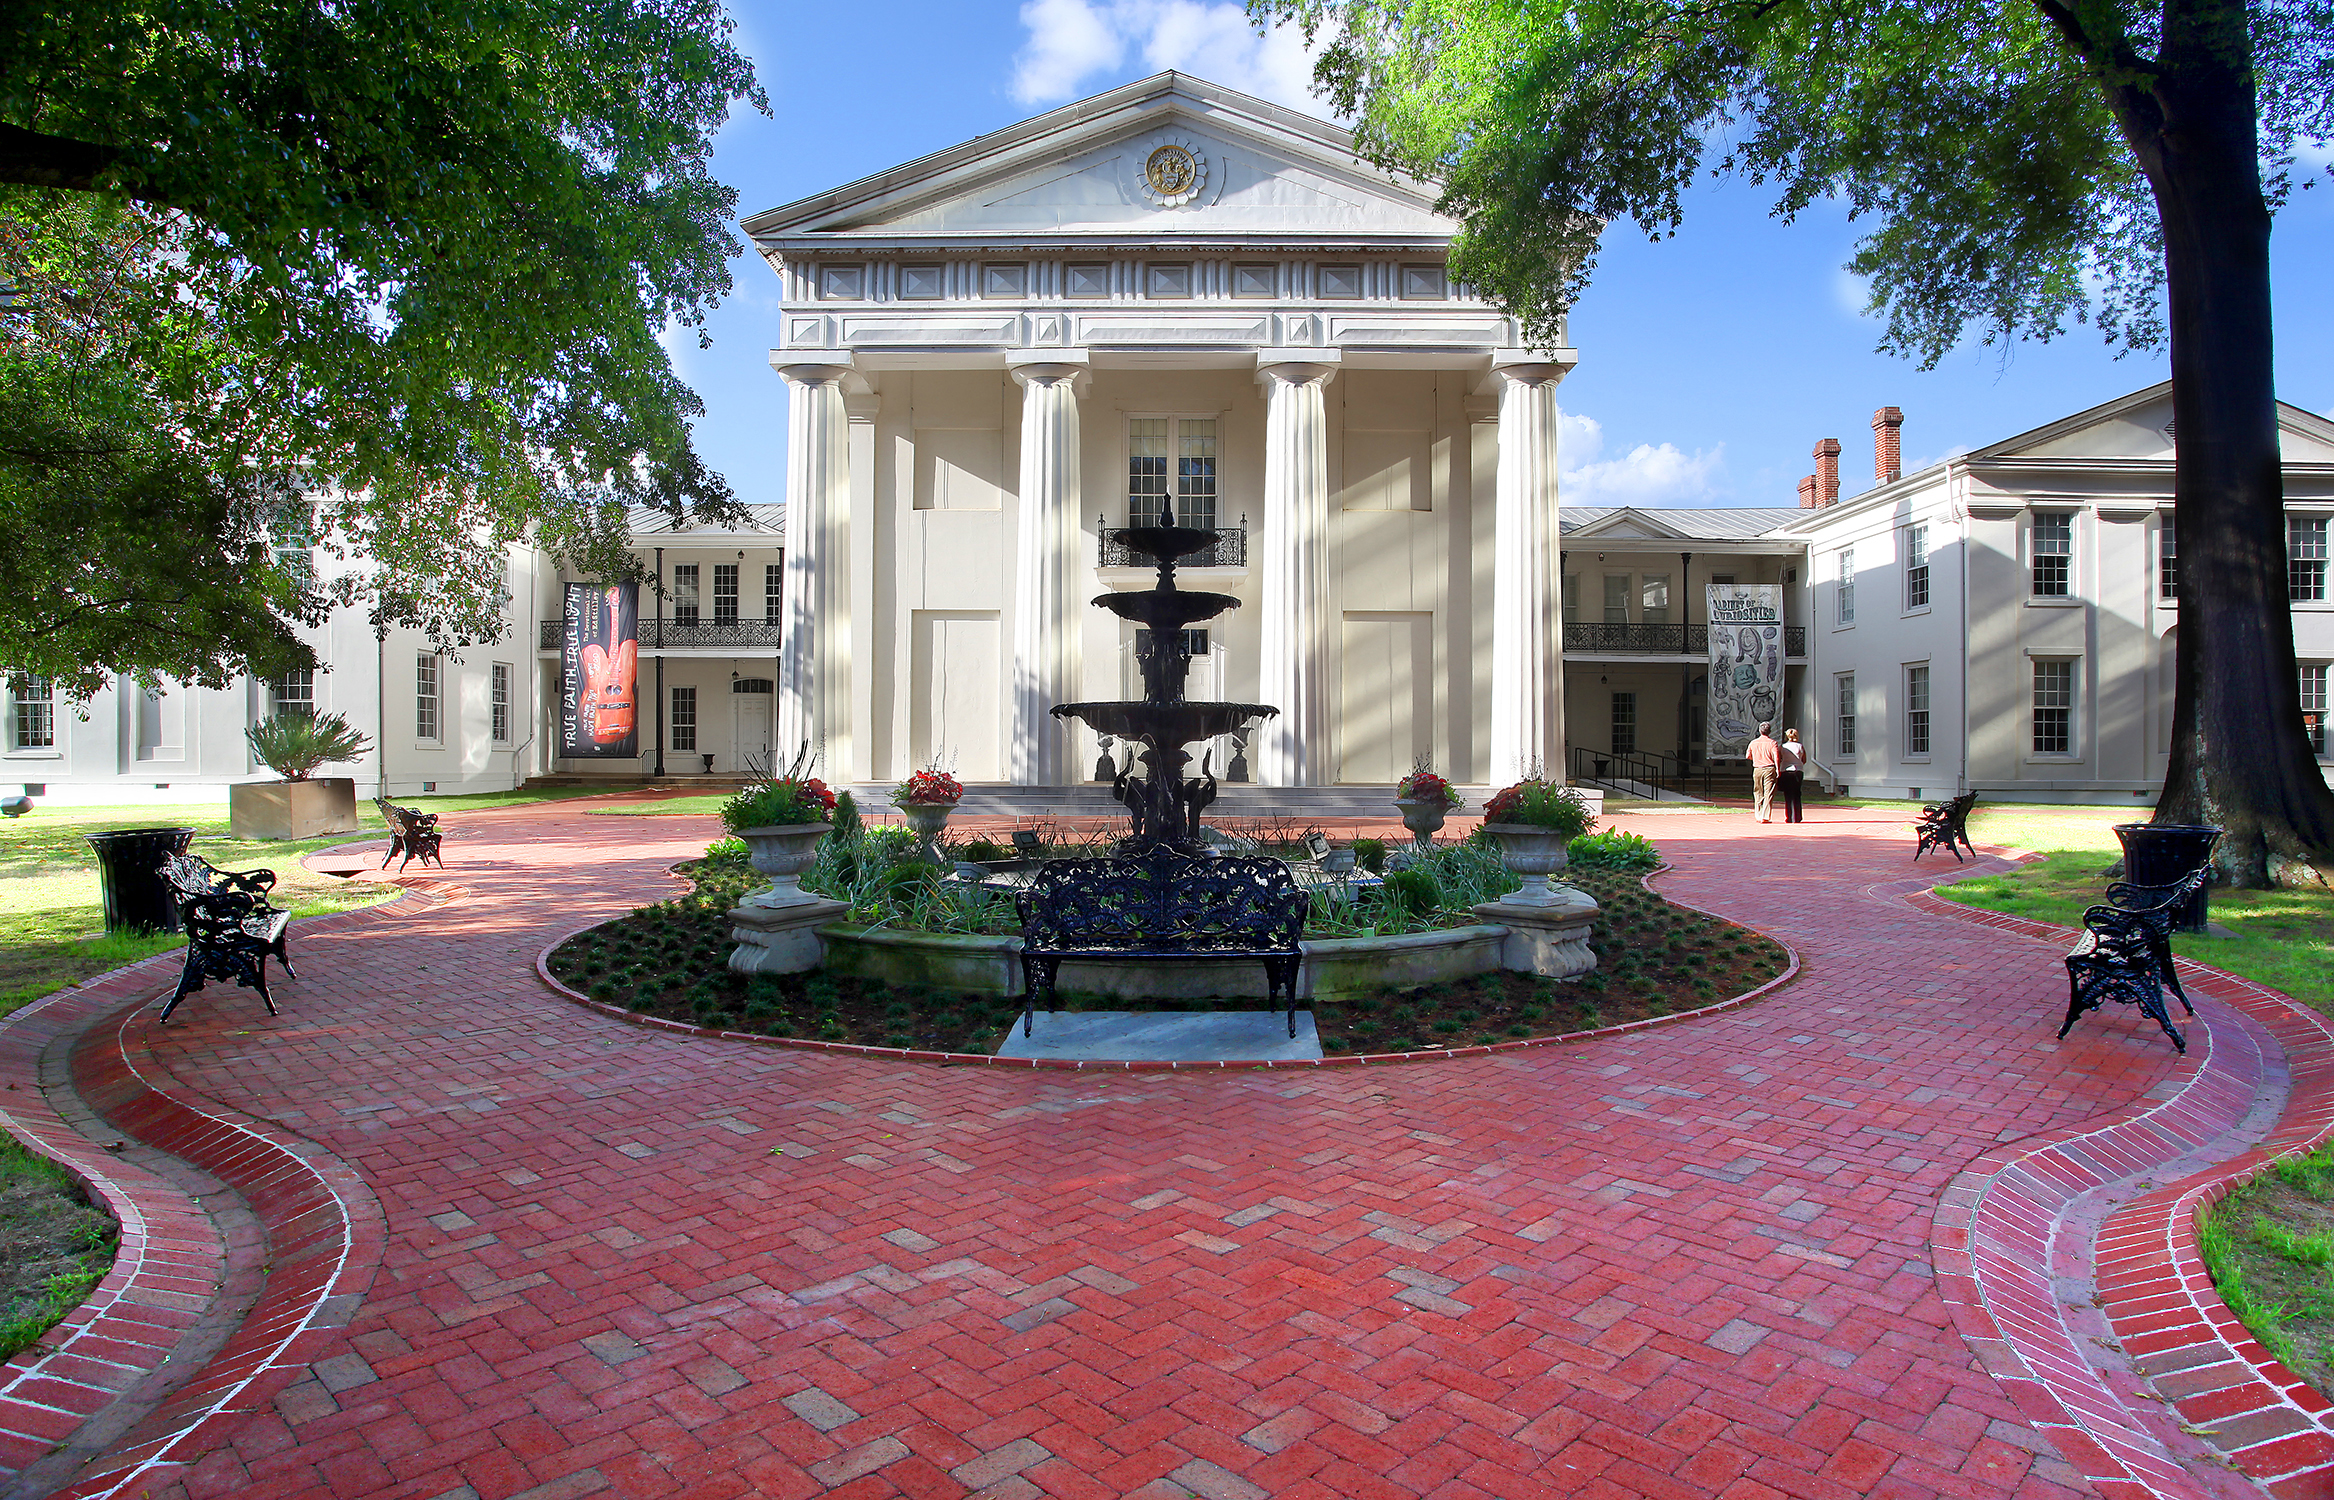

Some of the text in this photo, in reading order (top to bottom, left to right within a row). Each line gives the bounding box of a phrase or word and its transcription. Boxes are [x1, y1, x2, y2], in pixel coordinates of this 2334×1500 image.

[566, 584, 581, 626] LIGHT
[1713, 600, 1744, 611] CABINET
[1713, 607, 1775, 620] CURIOSITIES
[592, 620, 598, 630] Ed
[566, 629, 578, 664] TRUE
[564, 715, 577, 748] TRUE
